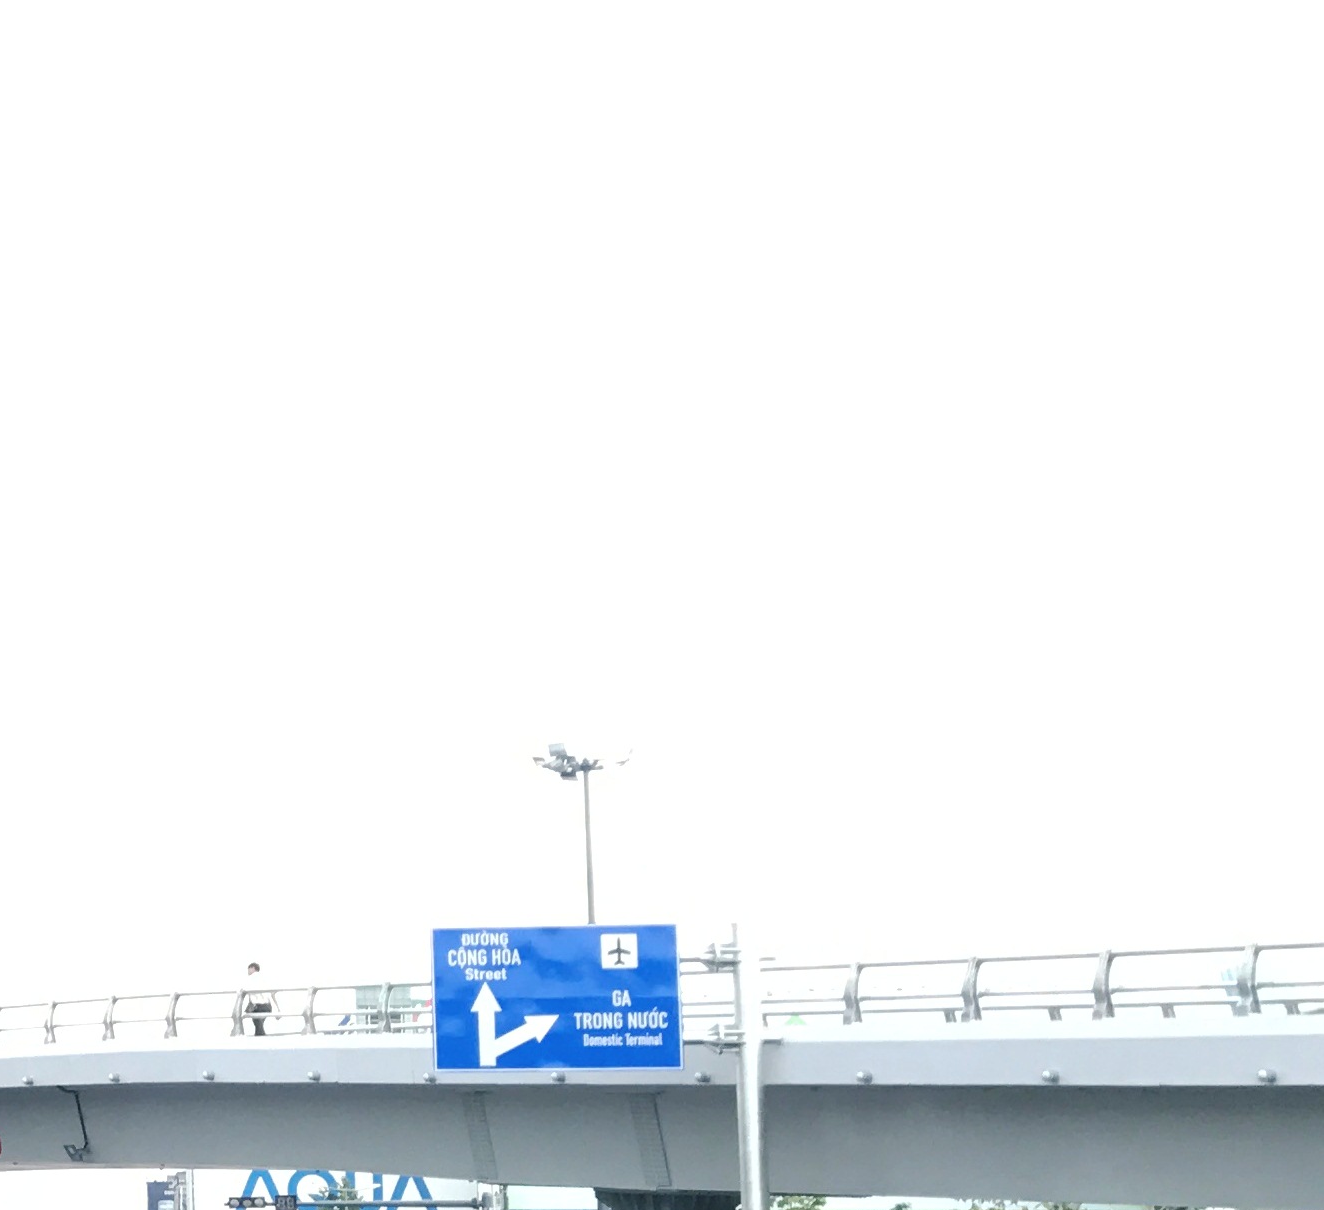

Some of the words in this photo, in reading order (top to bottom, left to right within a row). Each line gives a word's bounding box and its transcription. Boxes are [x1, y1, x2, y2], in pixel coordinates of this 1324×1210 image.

[461, 931, 508, 947] ĐƯỜNG
[448, 947, 487, 969] CỘNG
[492, 948, 521, 965] HÒA
[465, 968, 507, 981] Street
[612, 990, 631, 1007] GA
[574, 1012, 623, 1030] TRONG
[628, 1008, 668, 1029] NƯỚC
[583, 1033, 623, 1046] Domestic
[626, 1033, 663, 1046] Terminal
